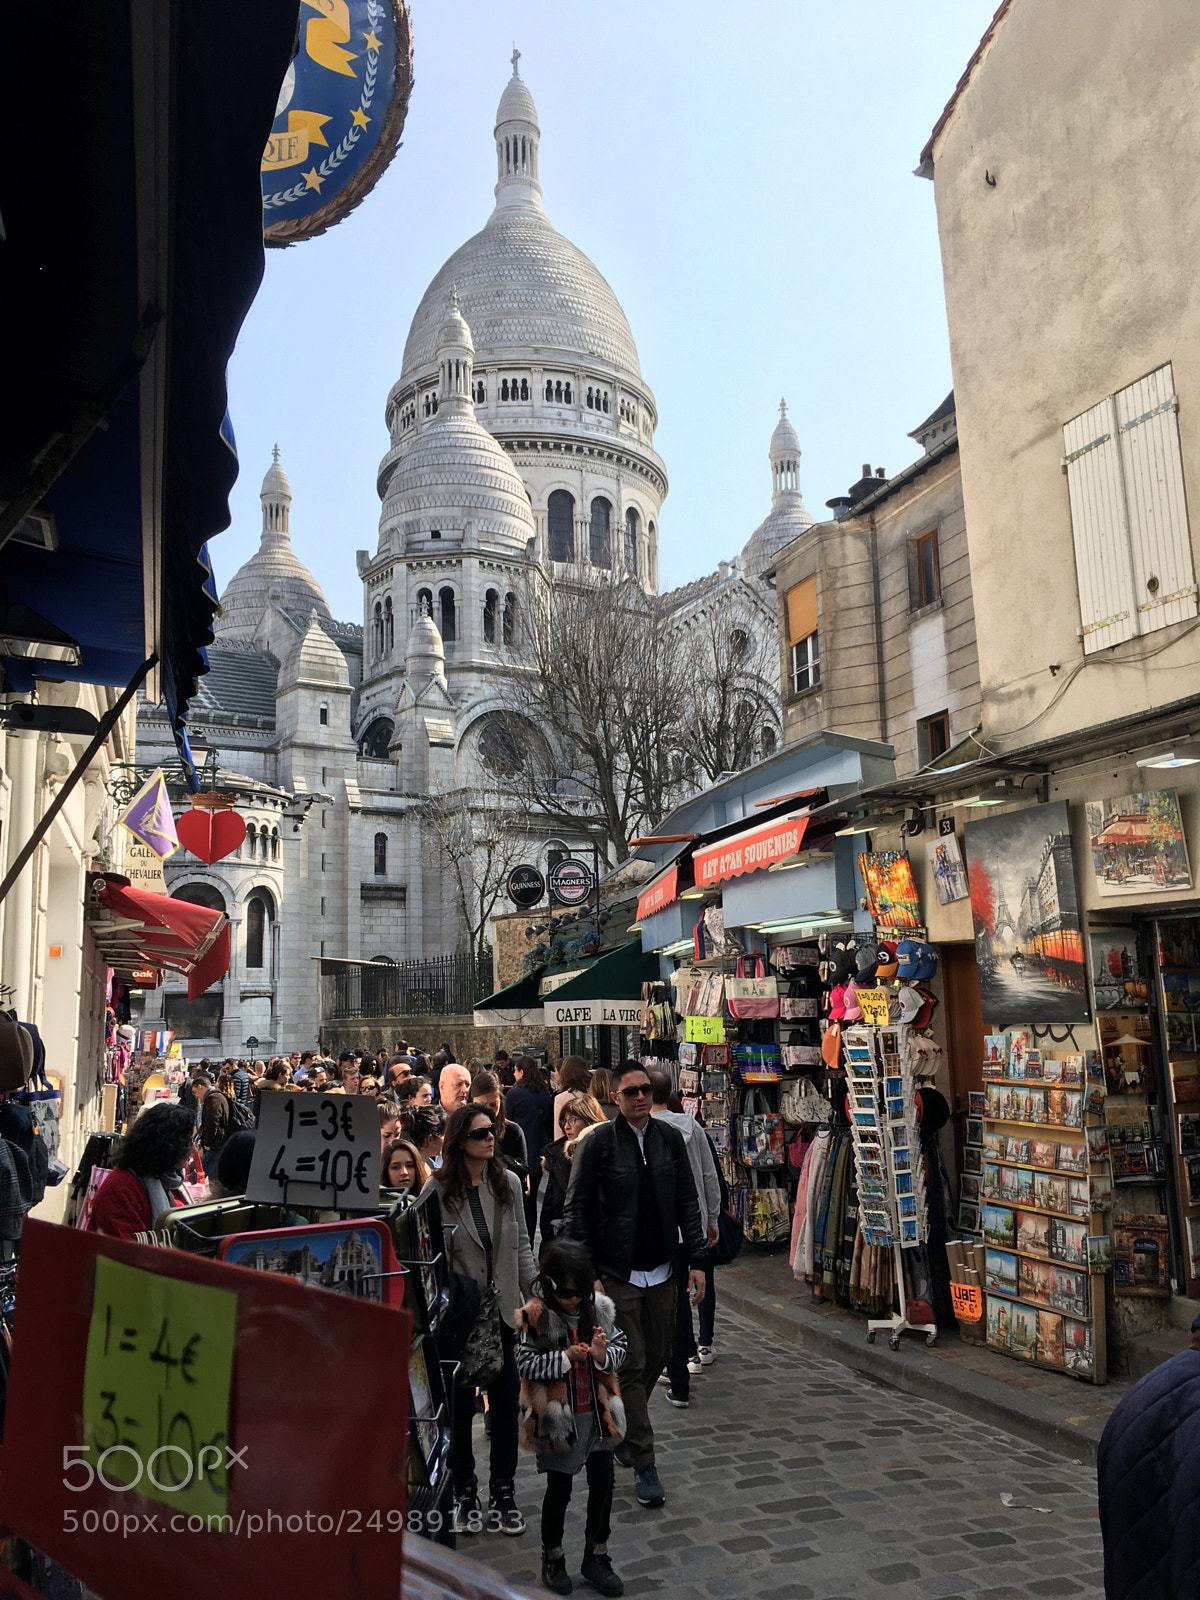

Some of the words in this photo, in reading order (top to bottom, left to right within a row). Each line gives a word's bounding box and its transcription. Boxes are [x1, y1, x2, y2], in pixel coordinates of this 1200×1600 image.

[943, 820, 951, 833] 53
[744, 828, 798, 866] SOUVENIRS
[124, 868, 162, 880] CHEVALIER
[511, 880, 541, 891] GUINNESS
[552, 878, 591, 887] MAGNERS
[556, 1007, 591, 1023] CAFE
[603, 1008, 617, 1021] LA
